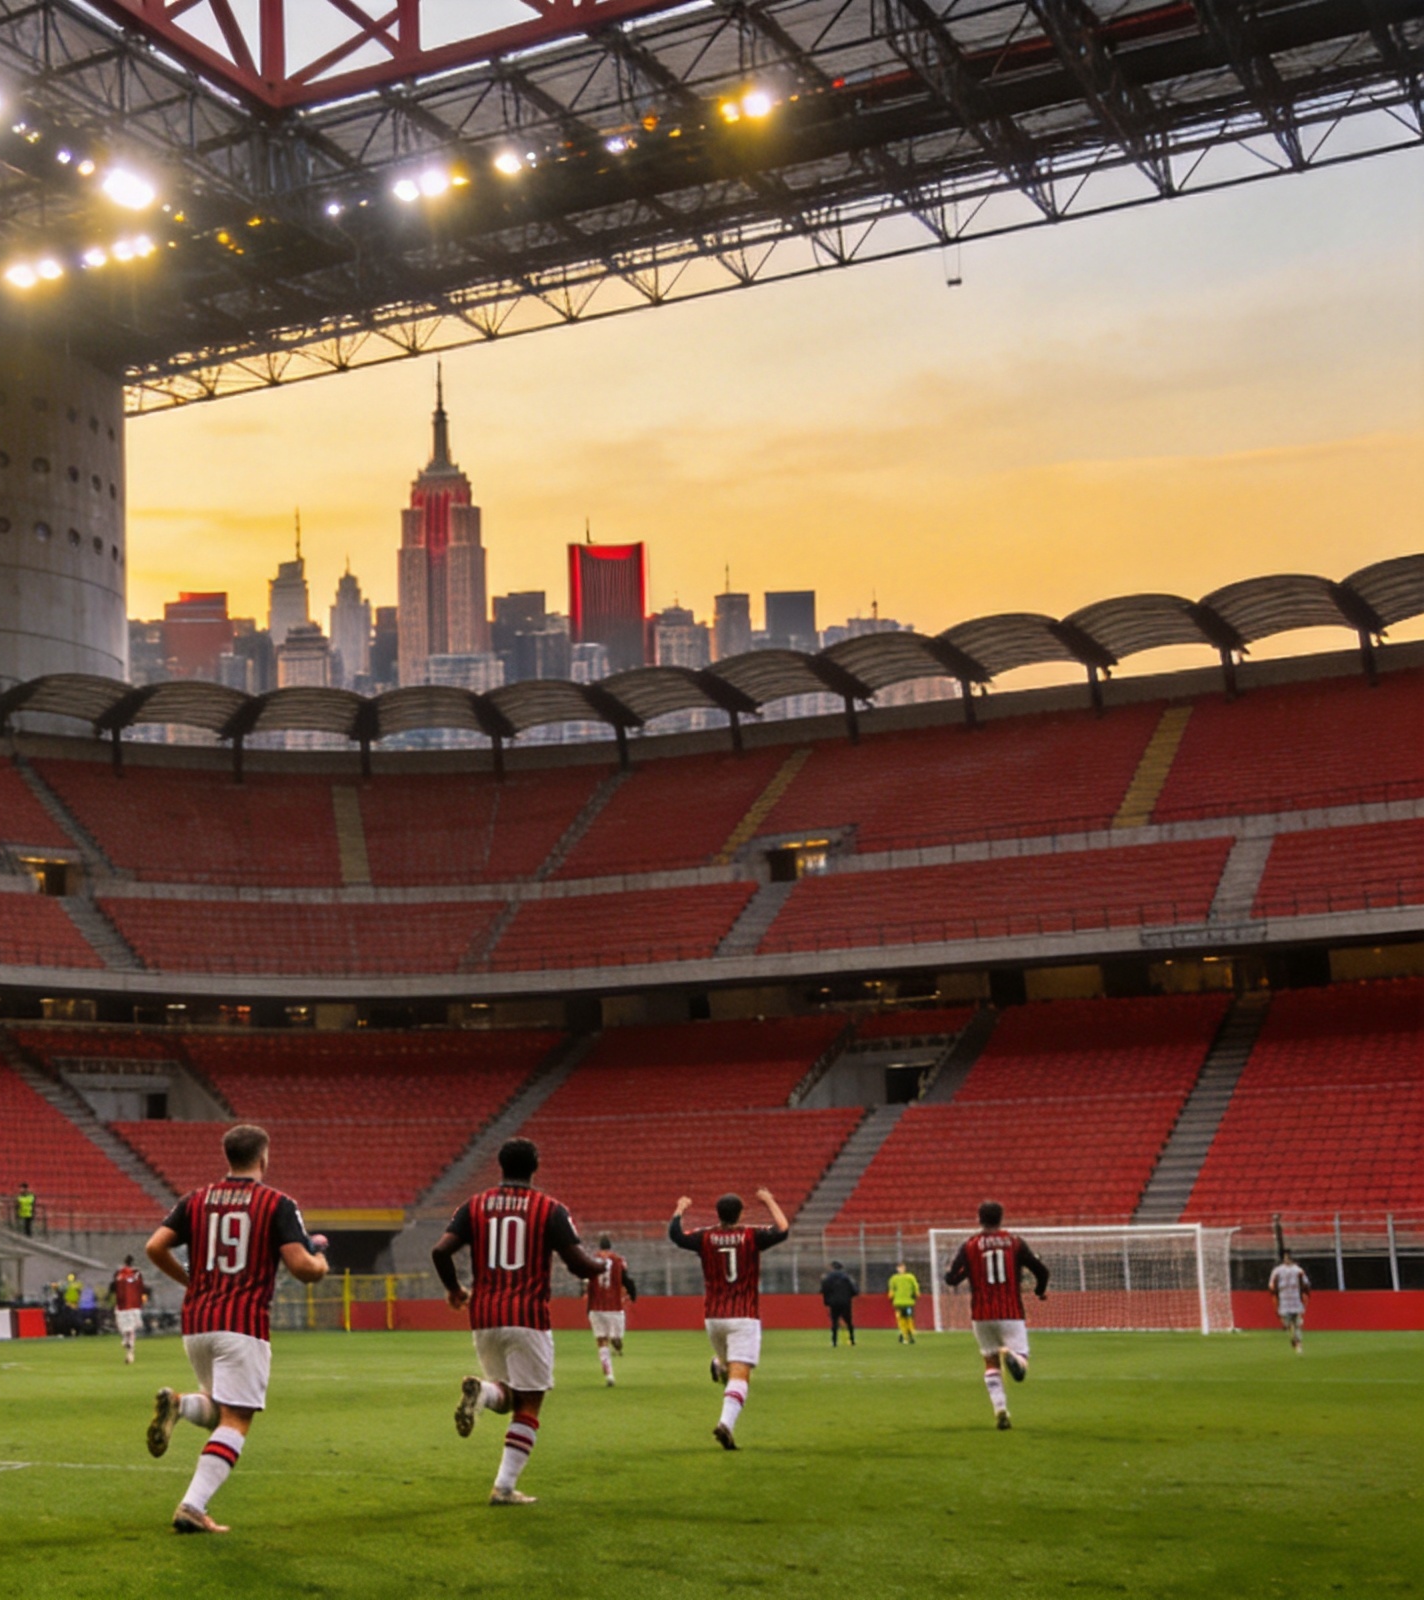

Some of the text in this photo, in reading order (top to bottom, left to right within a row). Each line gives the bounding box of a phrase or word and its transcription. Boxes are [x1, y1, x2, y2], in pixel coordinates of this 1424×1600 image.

[206, 1211, 251, 1274] 19
[488, 1216, 525, 1270] 10
[982, 1249, 1006, 1284] 11
